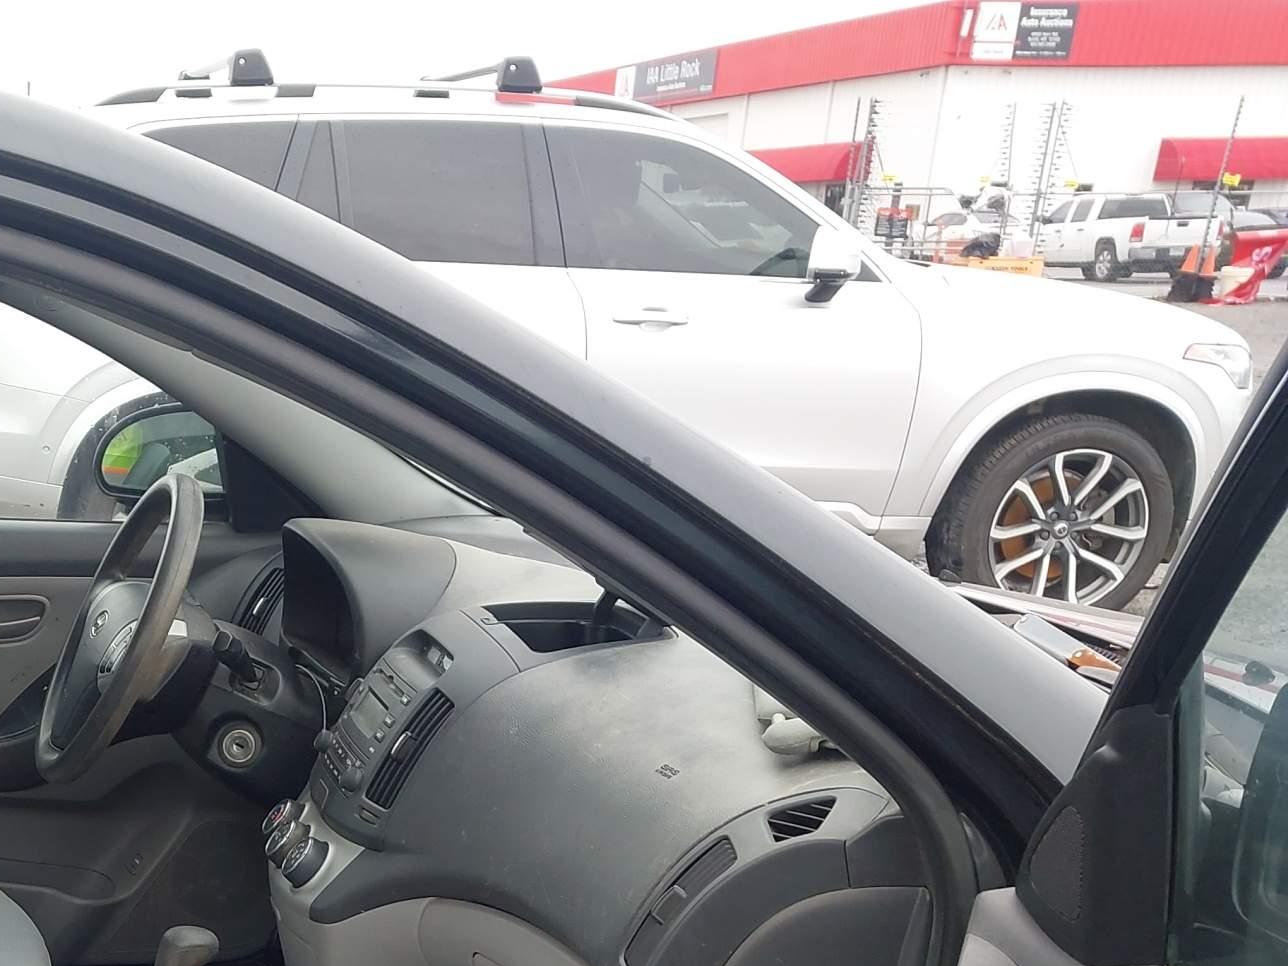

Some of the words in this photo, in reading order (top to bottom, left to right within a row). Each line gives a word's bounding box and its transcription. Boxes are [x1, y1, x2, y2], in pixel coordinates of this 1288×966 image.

[1020, 17, 1039, 27] Auto
[1040, 17, 1073, 28] Auctions
[646, 66, 659, 84] IAA
[660, 62, 679, 81] Little
[680, 57, 700, 78] Rock
